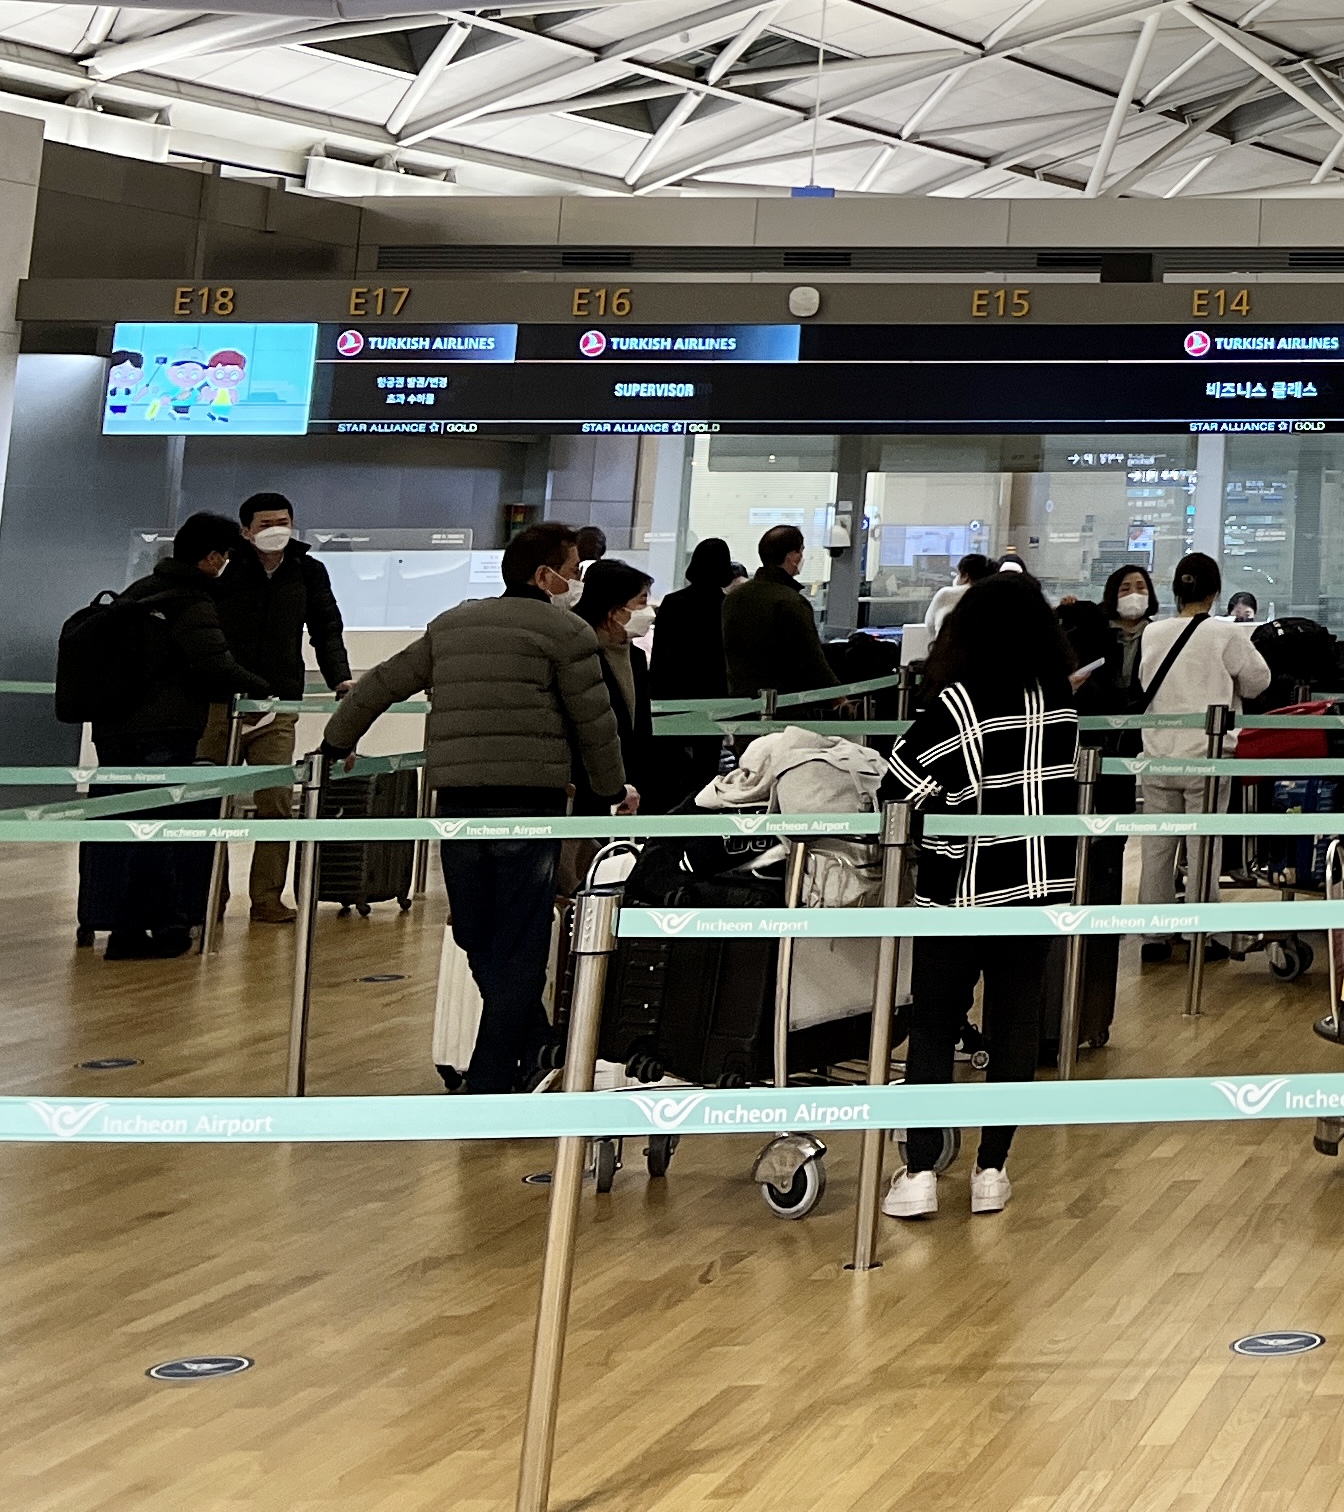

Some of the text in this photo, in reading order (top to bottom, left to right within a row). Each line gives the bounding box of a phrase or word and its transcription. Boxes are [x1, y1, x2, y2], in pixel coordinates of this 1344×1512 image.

[174, 286, 235, 316] E18
[350, 287, 411, 316] E17
[572, 288, 632, 316] E16
[971, 289, 1030, 317] E15
[1192, 289, 1250, 317] E14
[368, 337, 495, 350] TURKISH AIRLINES
[610, 338, 737, 351] TURKISH AIRLINES
[1214, 337, 1339, 350] TURKISH AIRLINES
[614, 383, 694, 398] SUPERVISOR
[1205, 381, 1318, 399] 비즈니스 클래스
[337, 423, 478, 433] STAR ALLIANCE GOLD
[581, 423, 720, 433] STAR ALLIANCE GOLD
[1189, 422, 1326, 432] STAR ALLIANCE GOLD
[163, 828, 250, 839] Incheon Airport
[466, 825, 552, 837] Incheon Airport
[766, 821, 849, 833] Incheon Airport
[1115, 821, 1197, 833] Incheon Airport
[696, 918, 808, 933] Incheon Airport
[1090, 914, 1199, 929] Incheon Airport
[703, 1102, 871, 1126] Incheon Airport
[102, 1114, 273, 1136] Incheon Airport
